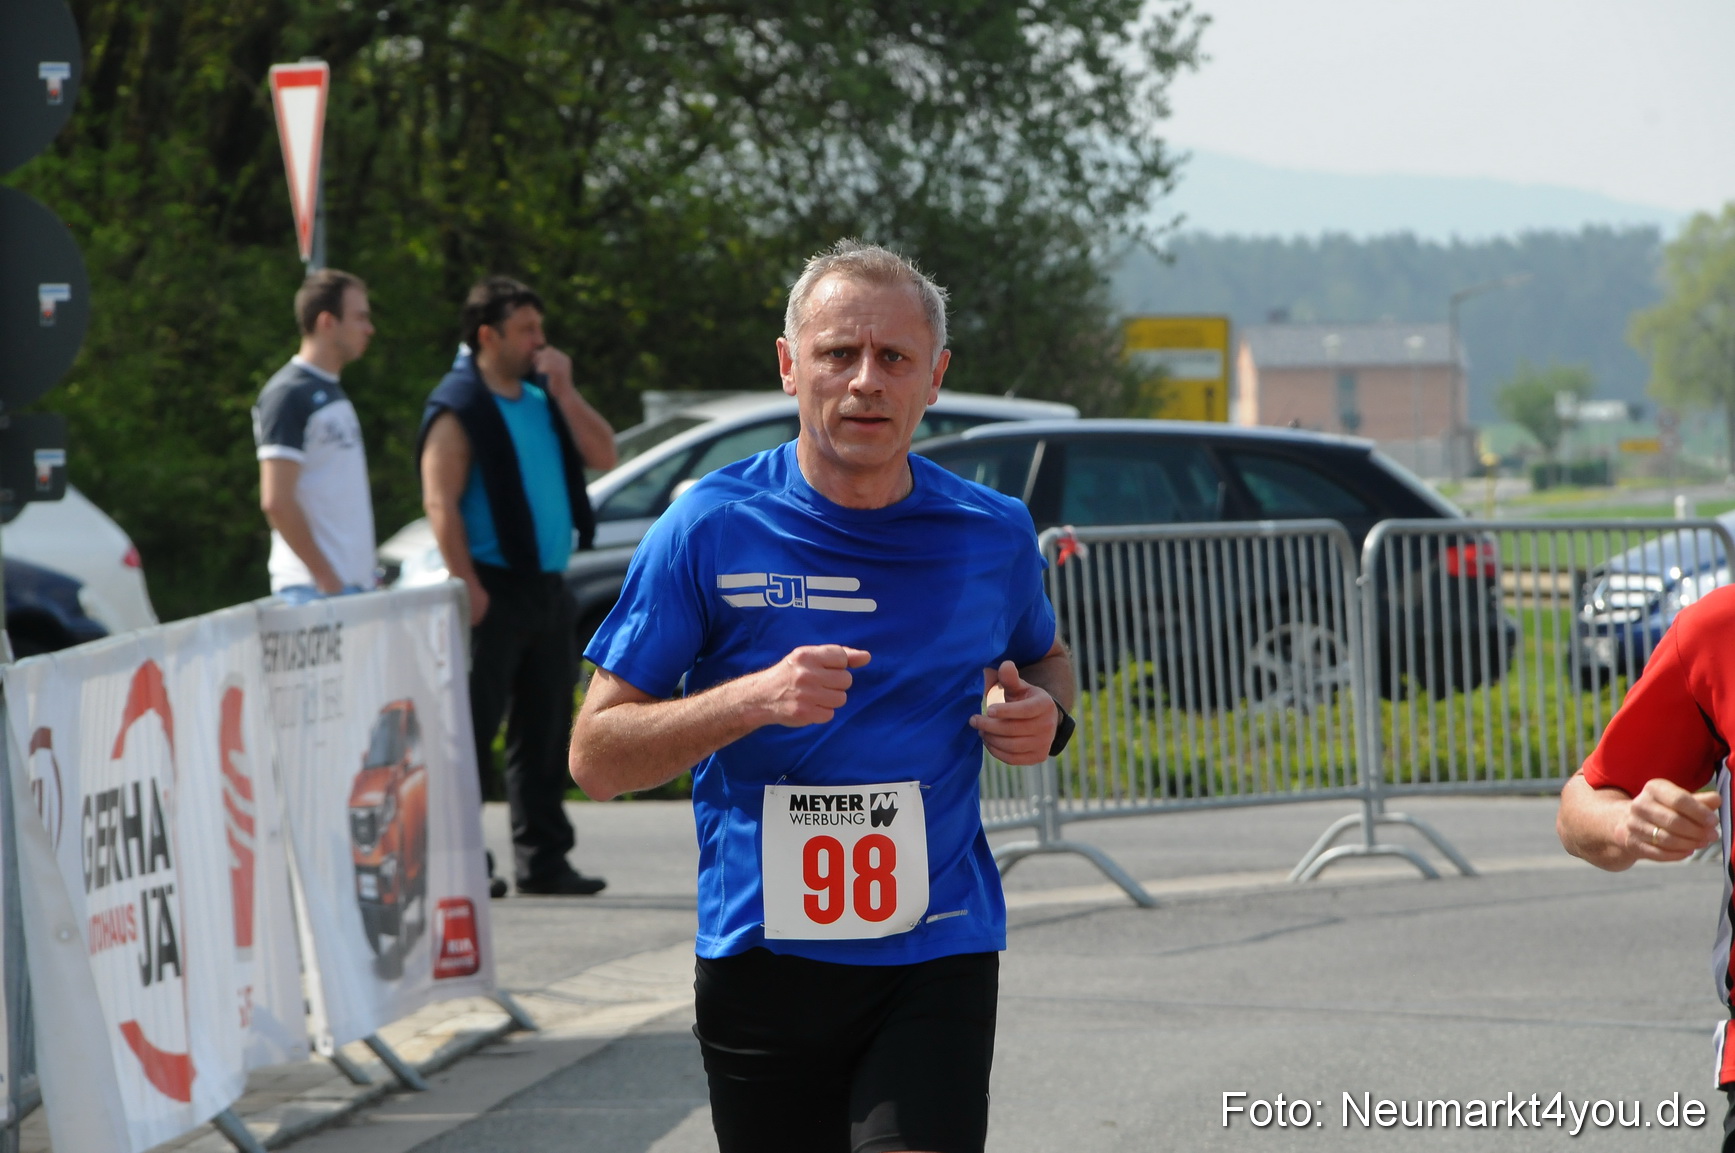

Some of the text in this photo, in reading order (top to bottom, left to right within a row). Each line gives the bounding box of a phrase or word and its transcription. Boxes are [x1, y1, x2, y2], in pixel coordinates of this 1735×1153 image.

[789, 794, 864, 812] MEYER
[789, 813, 866, 825] WERBUNG
[803, 833, 897, 925] 98
